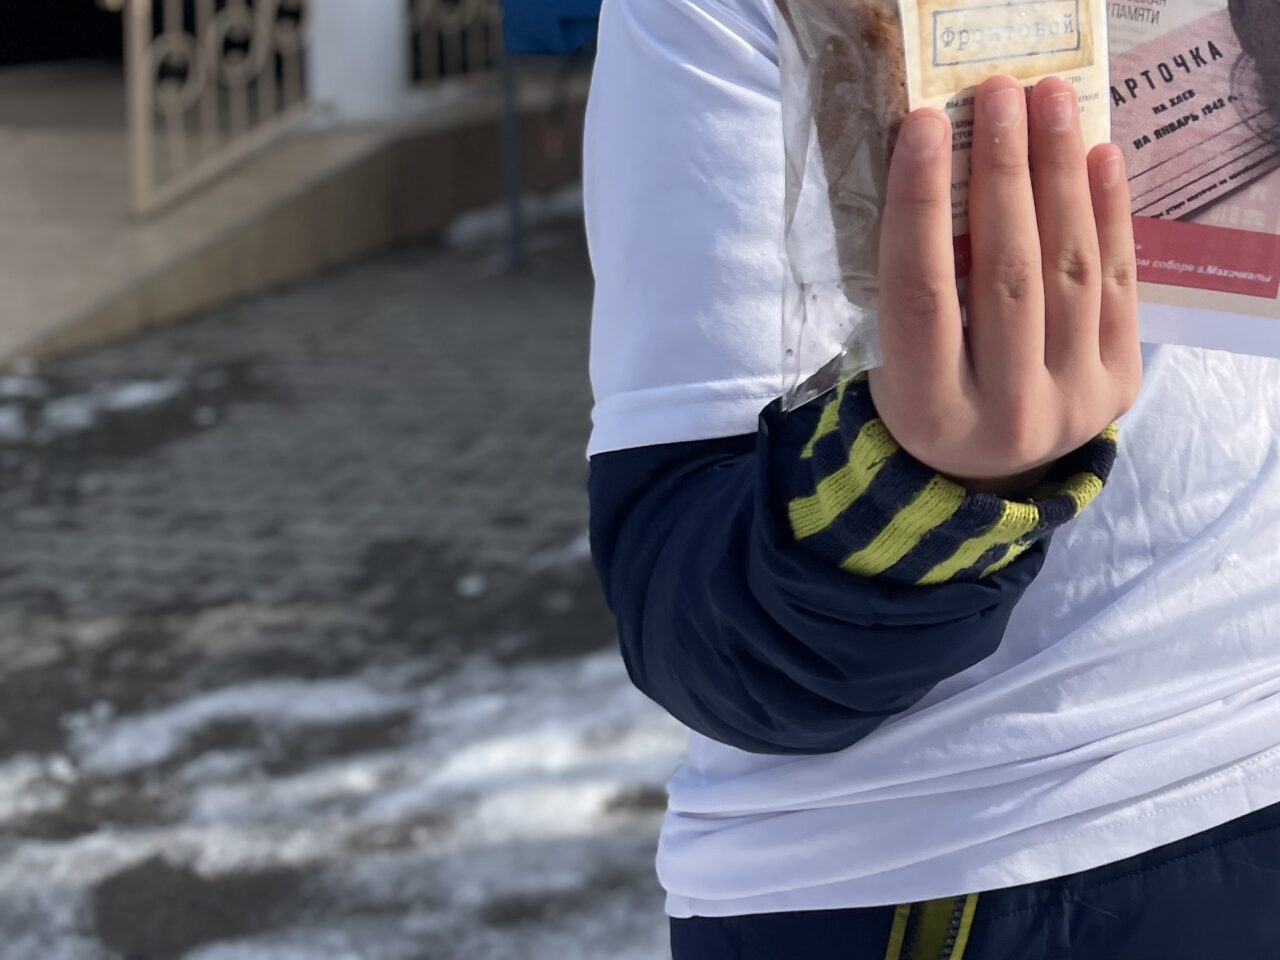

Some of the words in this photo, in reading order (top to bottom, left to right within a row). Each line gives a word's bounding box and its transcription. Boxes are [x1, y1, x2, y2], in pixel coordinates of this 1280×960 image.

[1112, 3, 1160, 24] ПАМЯТИ
[1110, 40, 1223, 107] АРТОЧКА
[1133, 134, 1152, 150] НА
[1153, 113, 1200, 139] ЯНВАРЬ
